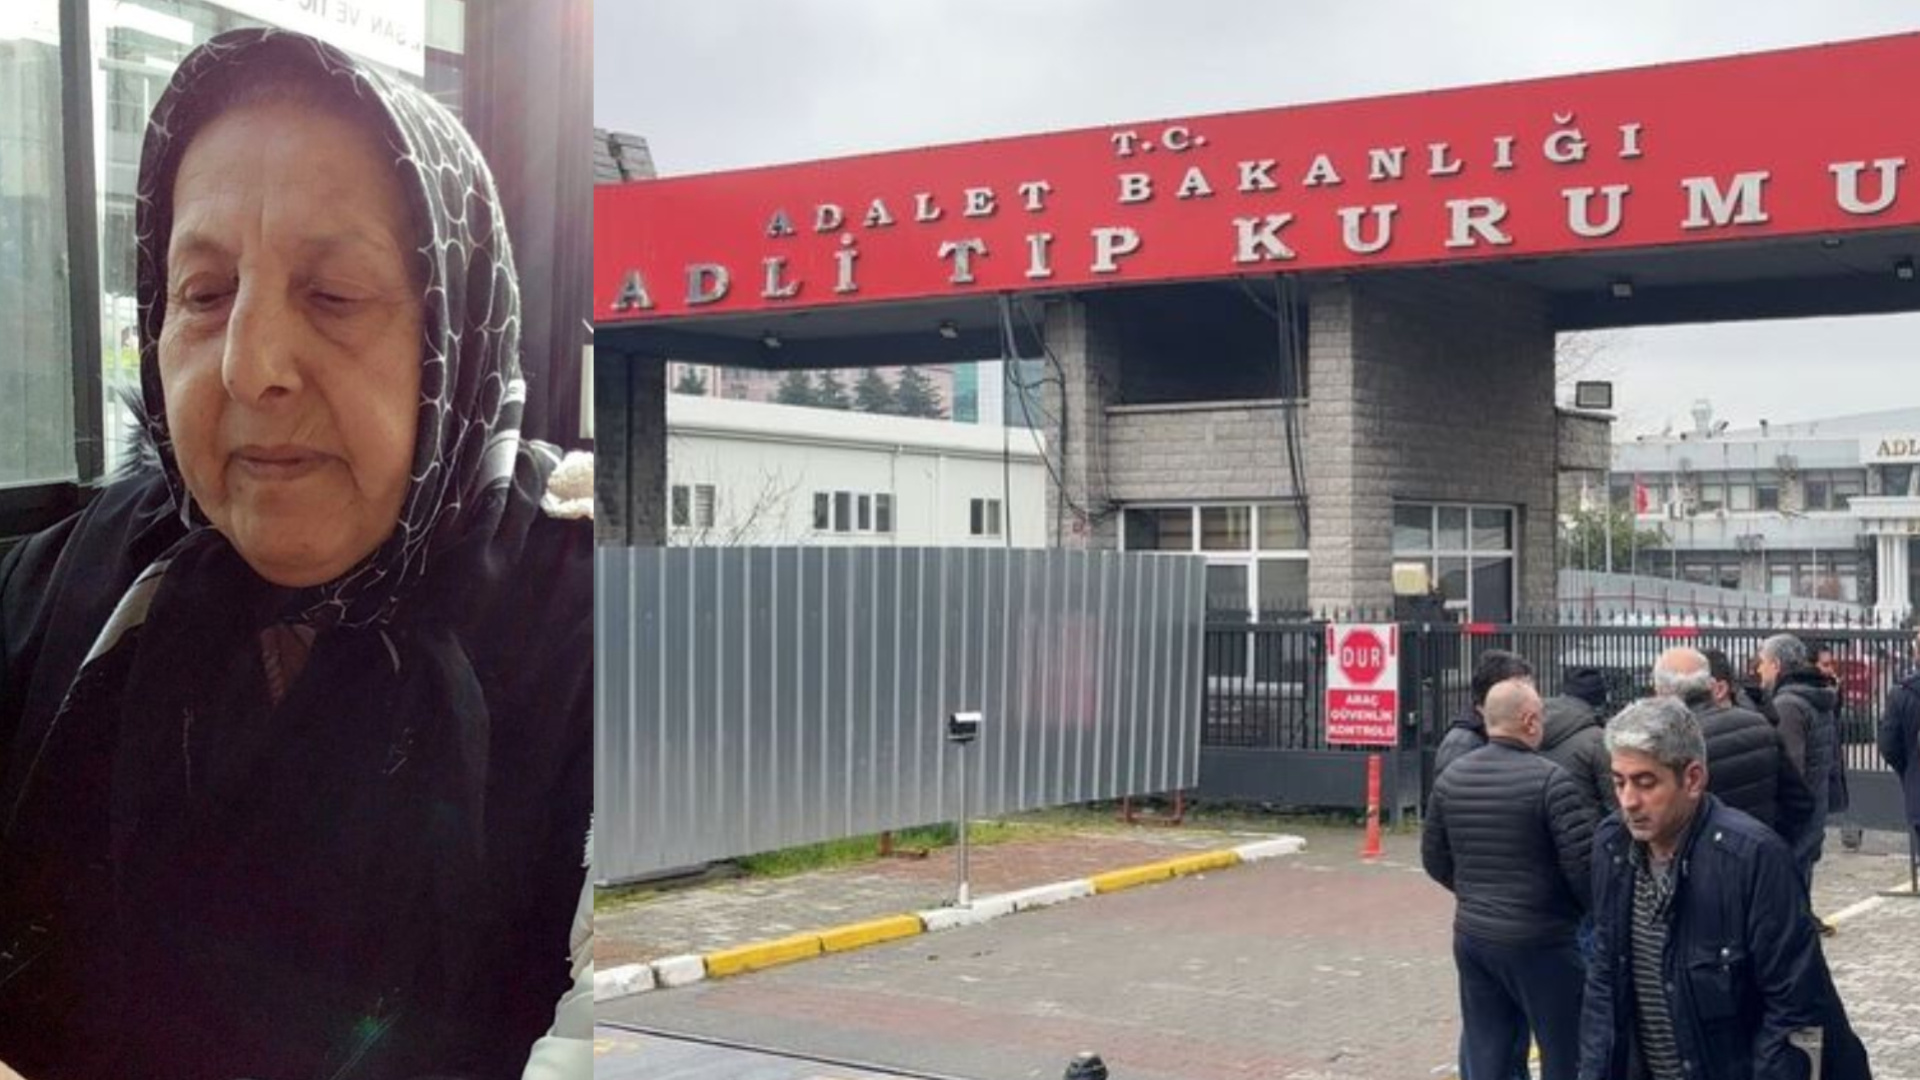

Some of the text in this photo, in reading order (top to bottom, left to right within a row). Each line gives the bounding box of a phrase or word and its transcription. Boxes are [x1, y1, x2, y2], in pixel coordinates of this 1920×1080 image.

[1111, 123, 1209, 158] T.C.
[764, 112, 1646, 239] ADALET BAKANLIĞI
[612, 158, 1908, 312] ADLİ TIP KURUMU
[1342, 647, 1380, 668] DUR
[1330, 708, 1392, 721] GÜVENLİK
[1345, 694, 1380, 708] ARAÇ
